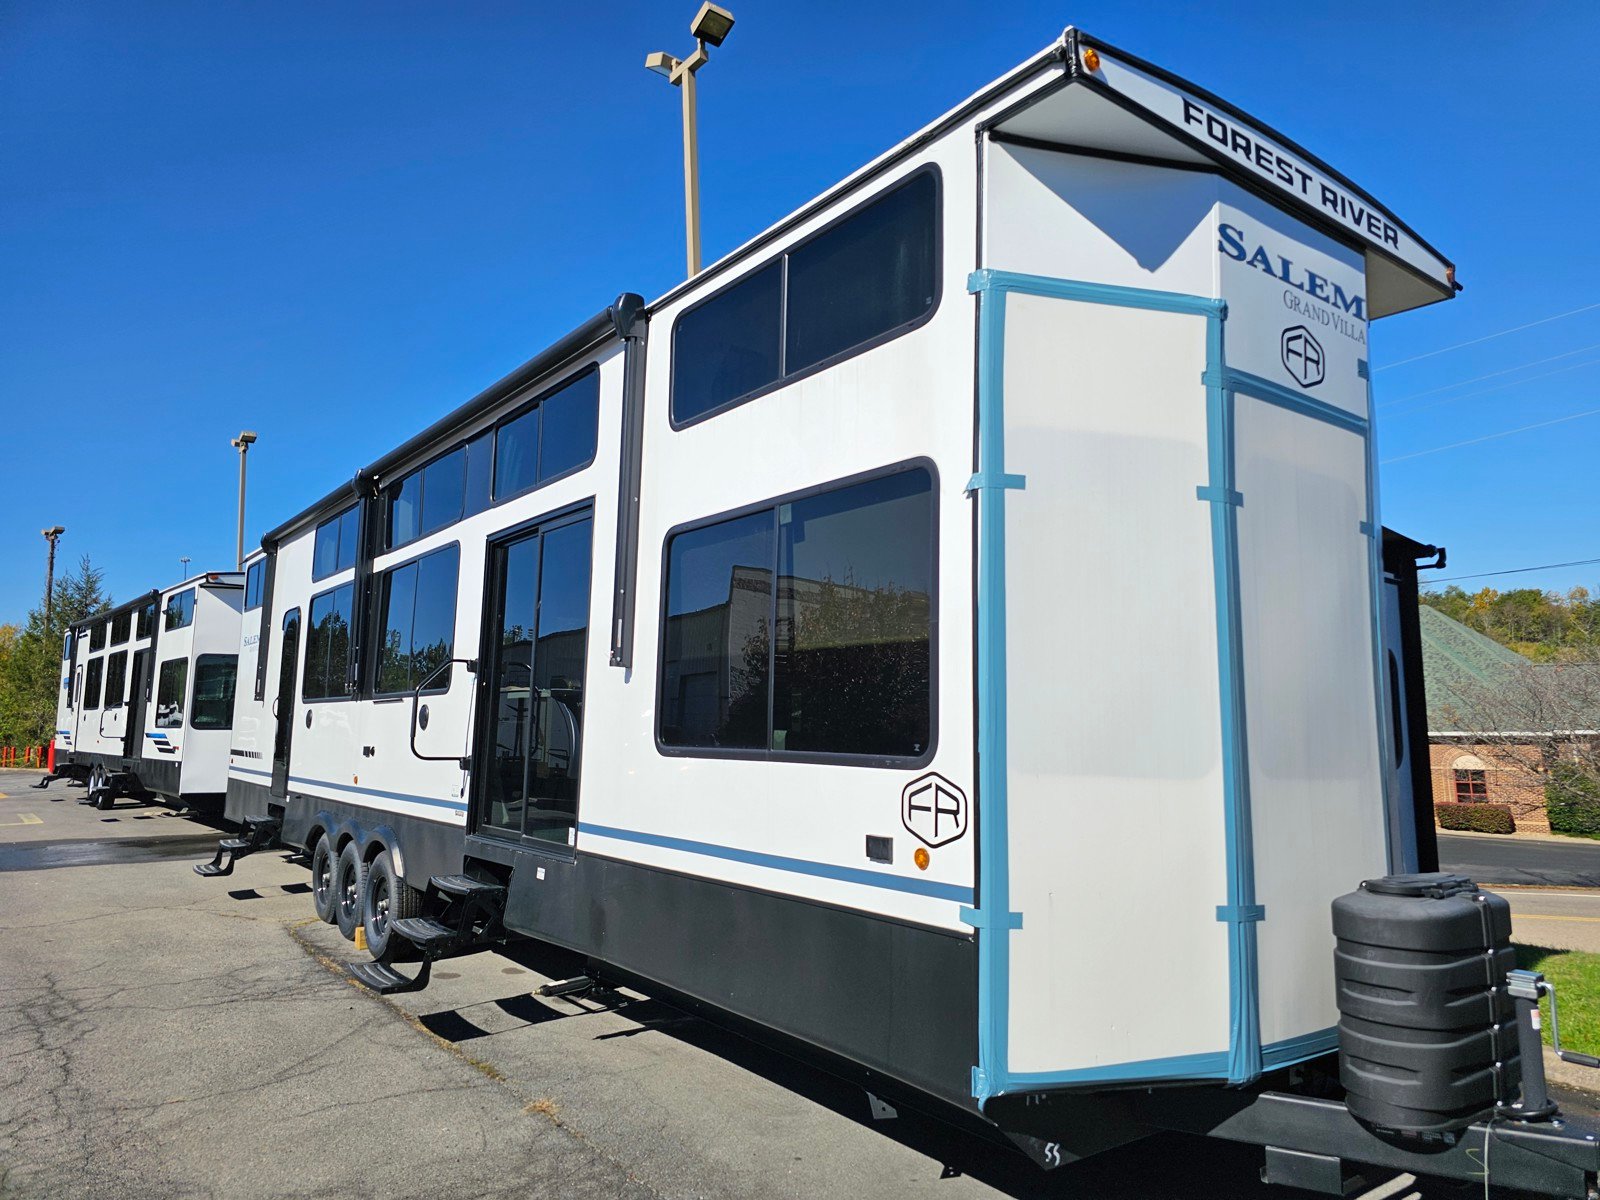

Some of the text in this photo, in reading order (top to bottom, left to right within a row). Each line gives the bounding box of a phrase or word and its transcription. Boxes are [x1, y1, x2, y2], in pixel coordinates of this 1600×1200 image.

[1182, 97, 1399, 251] FOREST RIVER
[1217, 222, 1366, 322] SALEM
[1286, 333, 1321, 380] FR
[908, 781, 960, 838] FR
